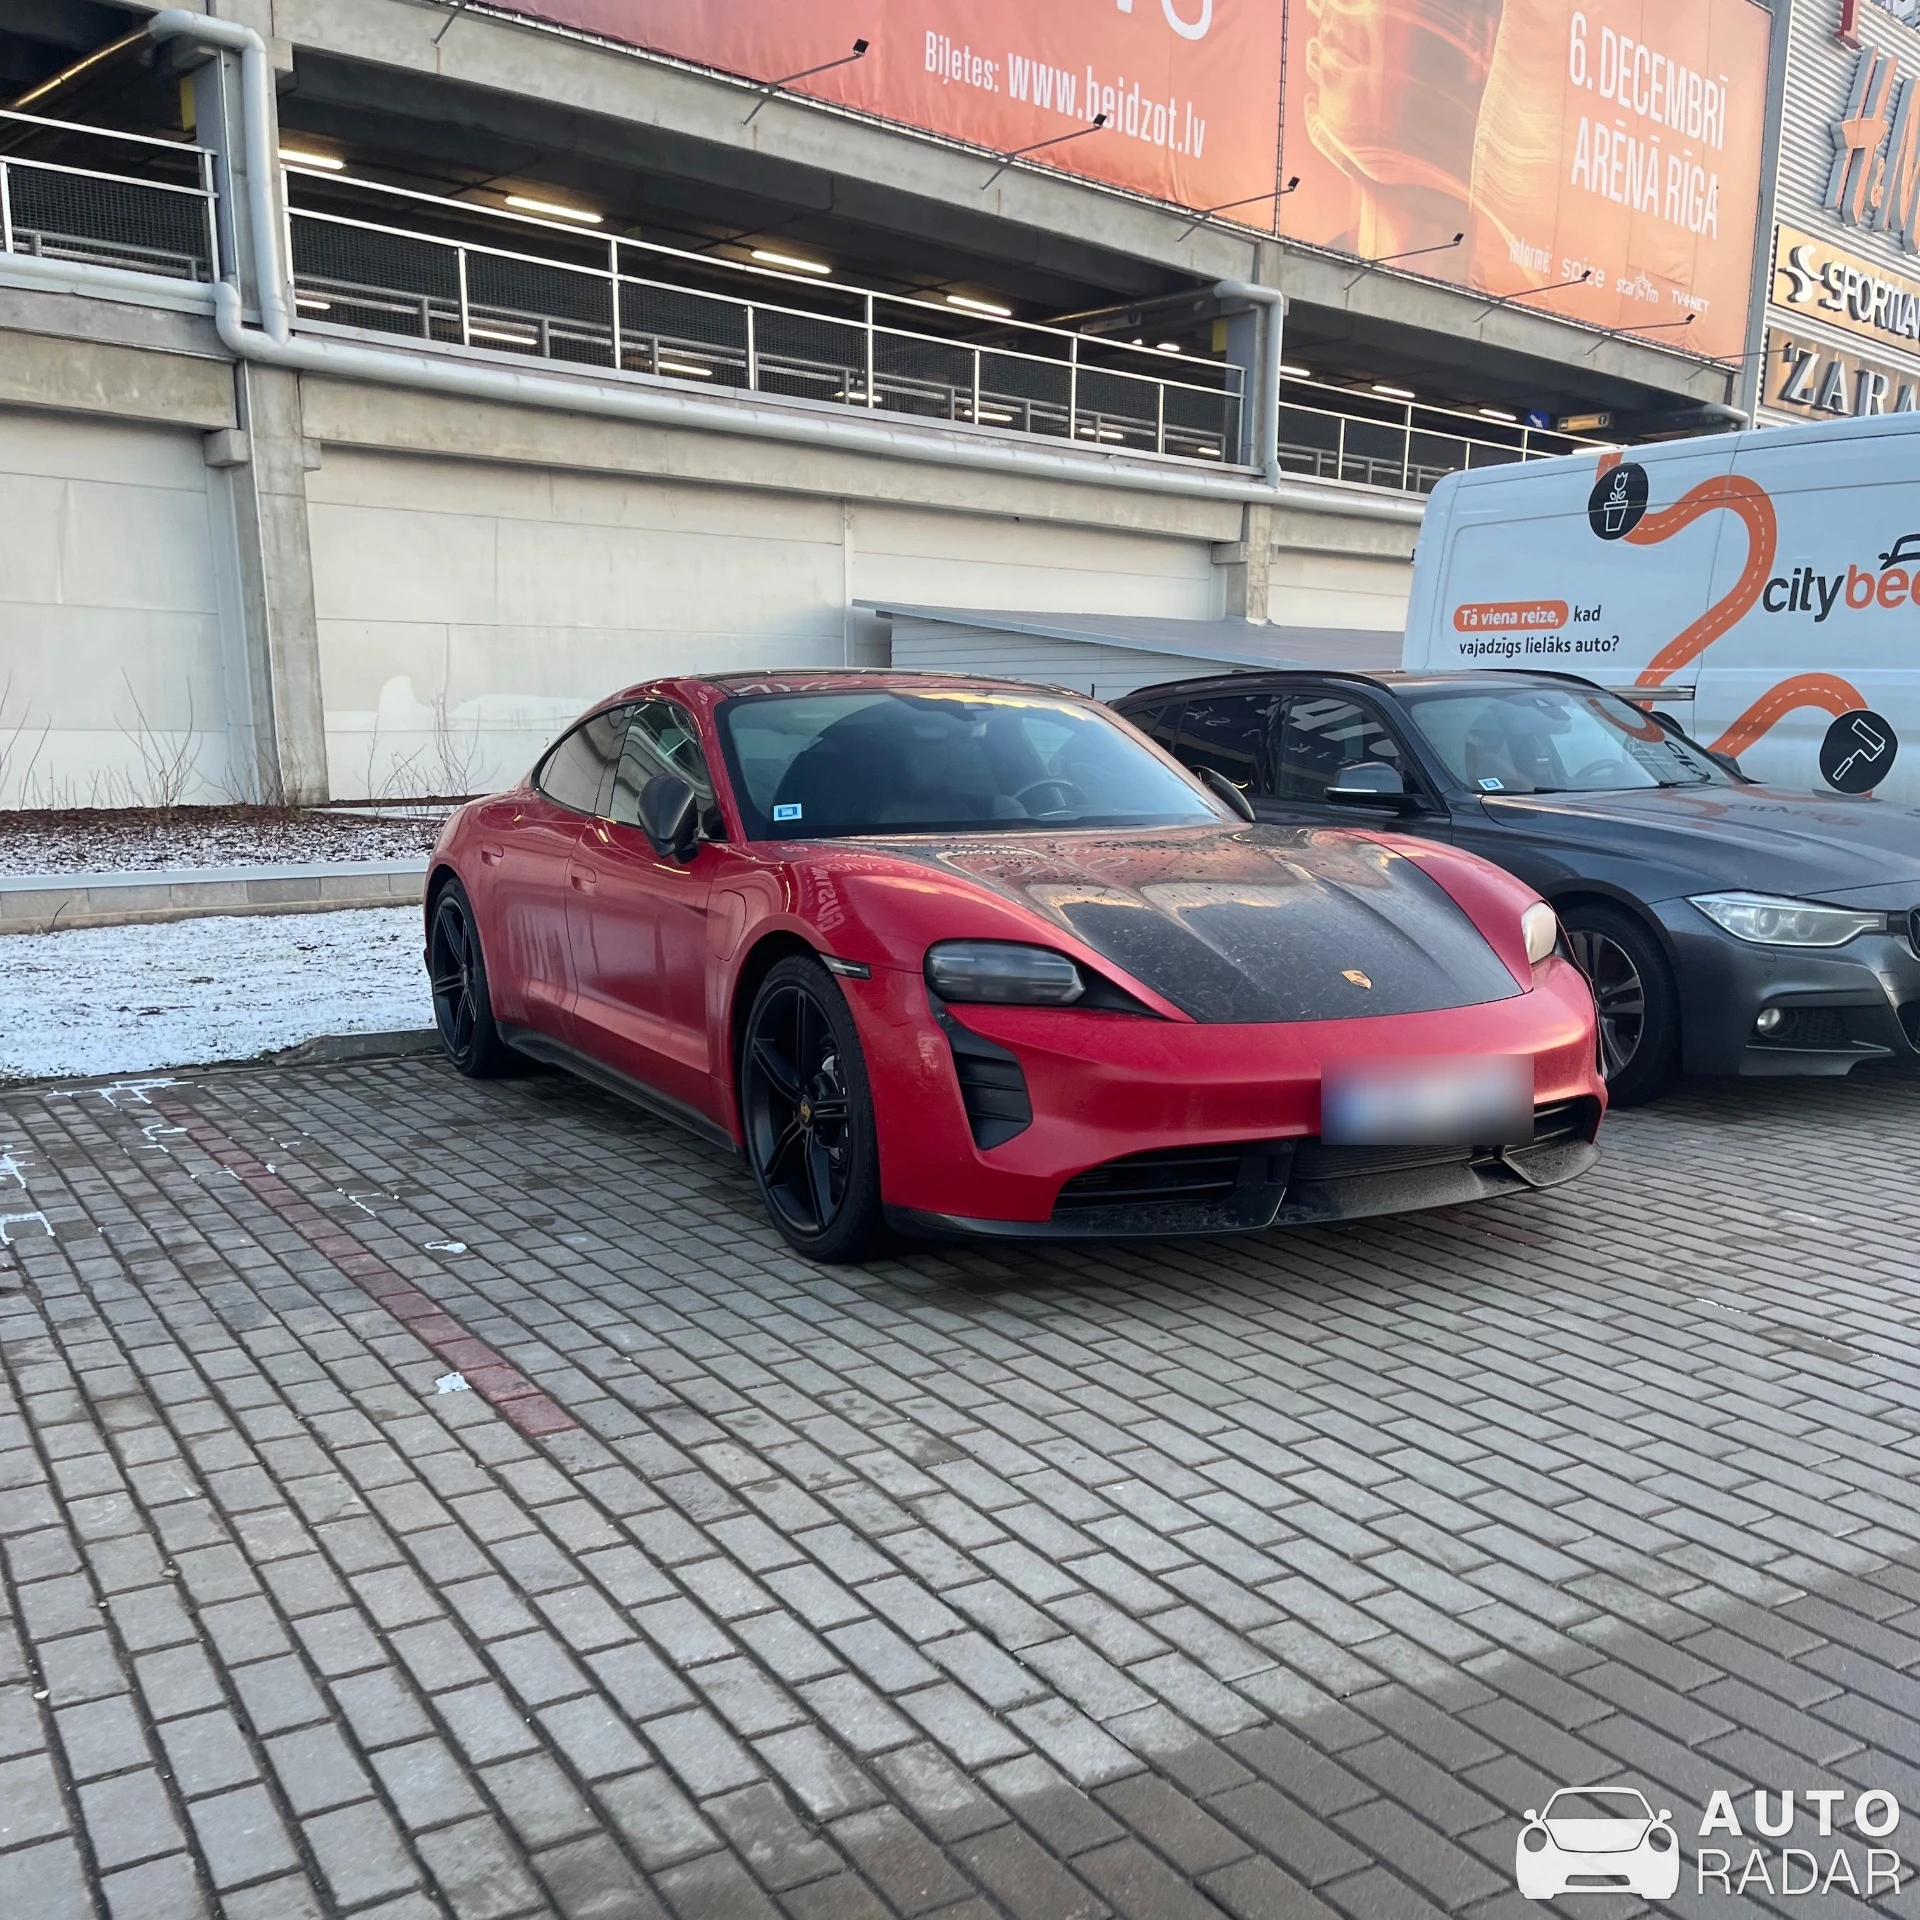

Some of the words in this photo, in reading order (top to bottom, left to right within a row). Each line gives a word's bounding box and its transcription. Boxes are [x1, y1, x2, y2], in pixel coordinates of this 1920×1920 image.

[925, 31, 1000, 93] Biļetes:
[1007, 52, 1206, 159] www.beidzot.lv
[1569, 11, 1593, 91] 6.
[1599, 25, 1729, 151] DECEMBRĪ
[1570, 116, 1659, 217] ARĒNĀ
[1664, 149, 1717, 240] RĪGA
[1822, 260, 1920, 340] SPORTLA
[1461, 608, 1478, 627] Tā
[1481, 608, 1518, 626] viena
[1521, 606, 1560, 627] reize,
[1573, 604, 1602, 622] kad
[1762, 564, 1920, 623] citybe
[1459, 637, 1522, 659] vajadzīgs
[1525, 636, 1571, 654] lielāks
[1575, 634, 1620, 653] auto?
